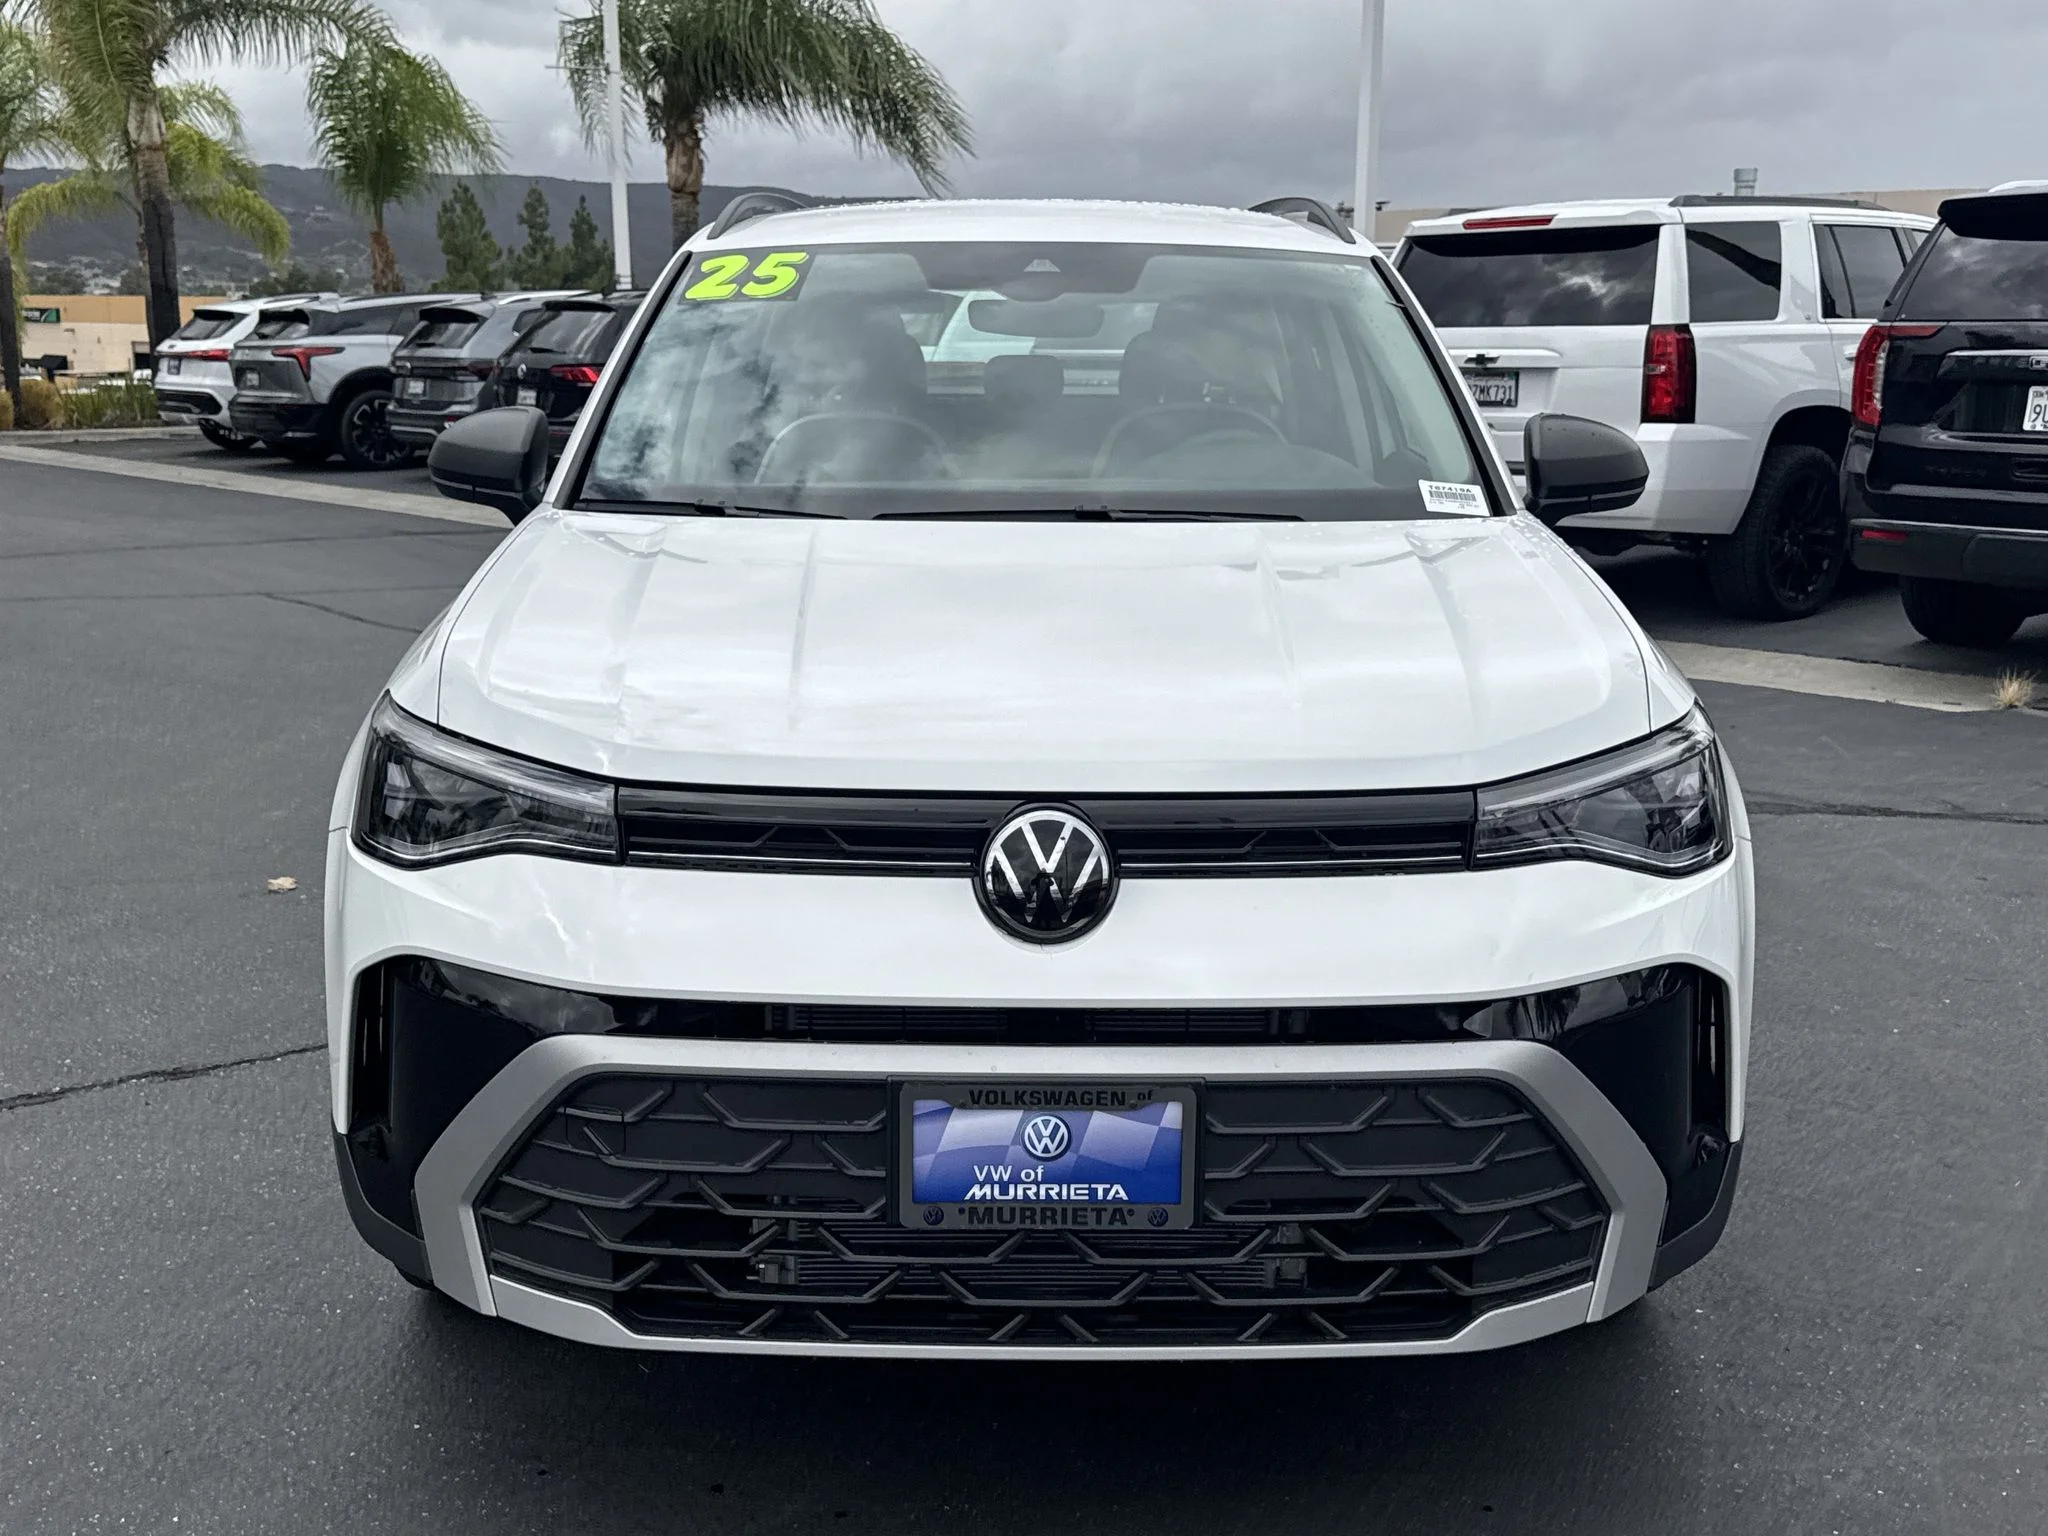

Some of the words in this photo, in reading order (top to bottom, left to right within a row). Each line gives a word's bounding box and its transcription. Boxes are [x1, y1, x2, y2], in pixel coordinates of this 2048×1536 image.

[685, 252, 809, 300] 25
[1468, 384, 1513, 401] ZMK731
[969, 1089, 1126, 1106] VOLKSWAGEN
[1137, 1090, 1153, 1101] of
[973, 1165, 1012, 1182] VW
[1021, 1165, 1044, 1182] of
[963, 1183, 1129, 1201] MURRIETA
